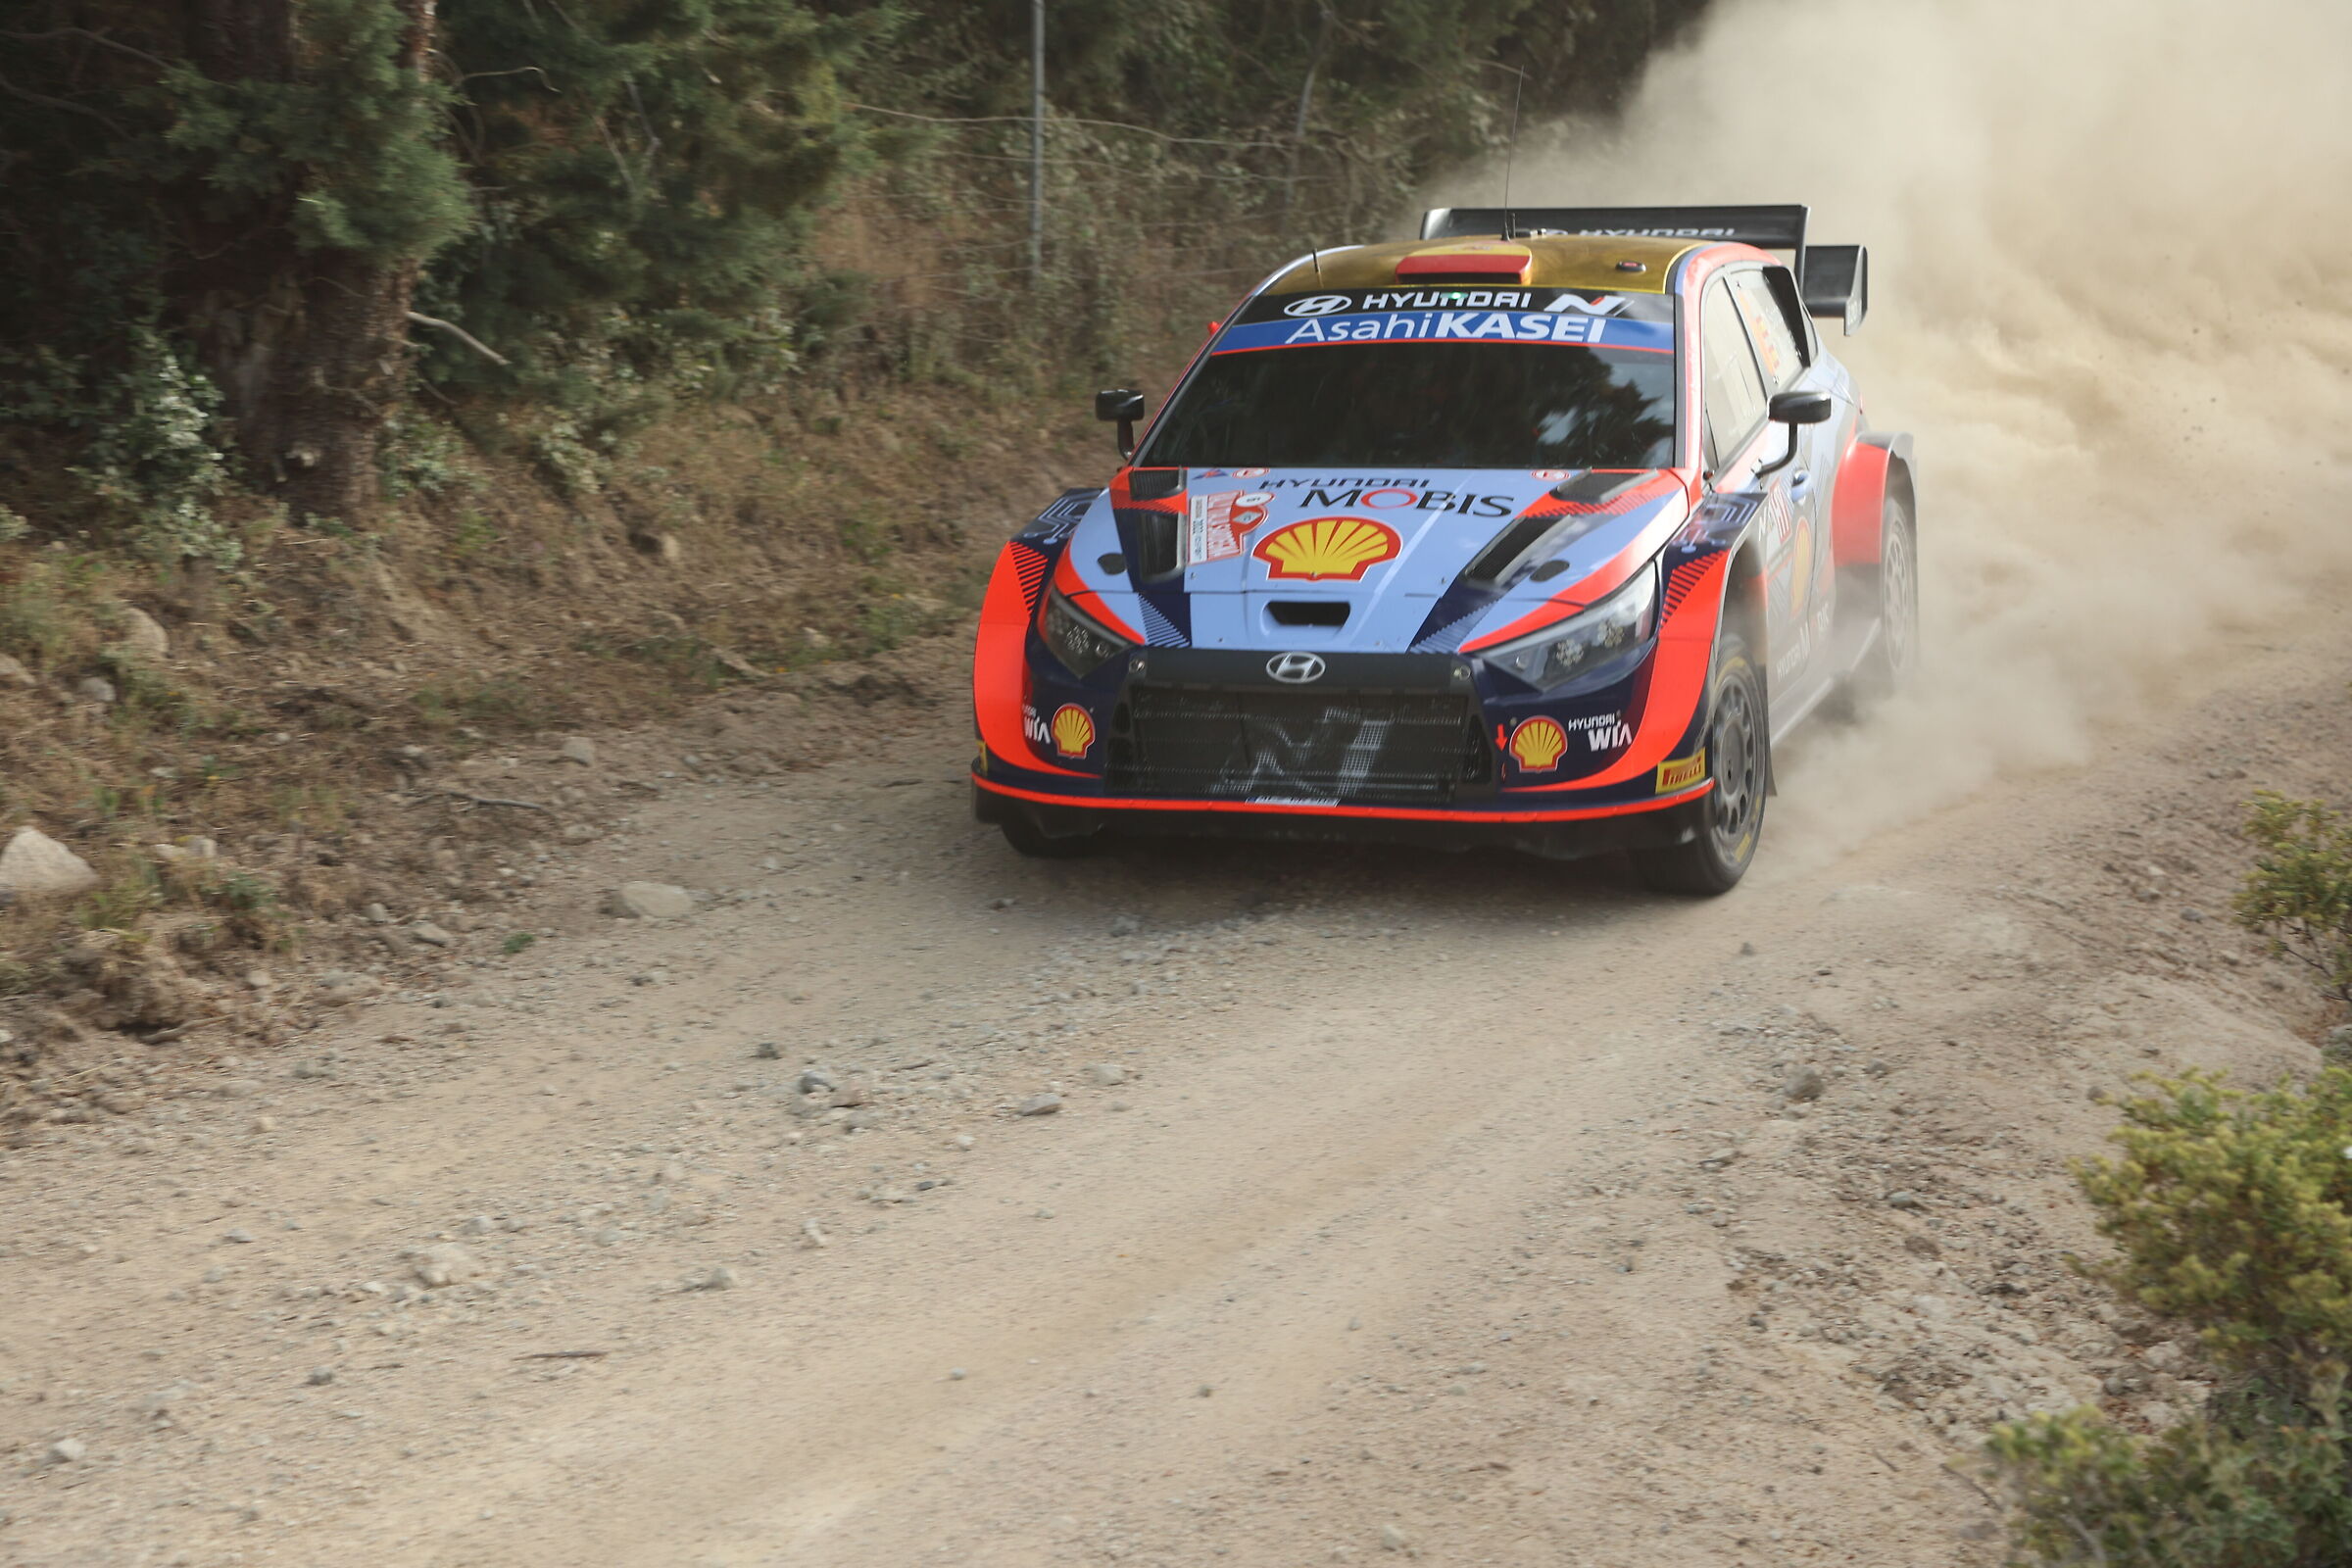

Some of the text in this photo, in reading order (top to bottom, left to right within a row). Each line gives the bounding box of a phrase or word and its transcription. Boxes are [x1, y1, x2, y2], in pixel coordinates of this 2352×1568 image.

[1362, 292, 1531, 309] HYUNDAI
[1285, 313, 1606, 344] AsahiKASEI
[1258, 478, 1430, 490] HYUNDAI
[1298, 488, 1514, 517] MOBIS
[1568, 713, 1615, 731] HYUNDAI
[1588, 720, 1633, 752] WIA
